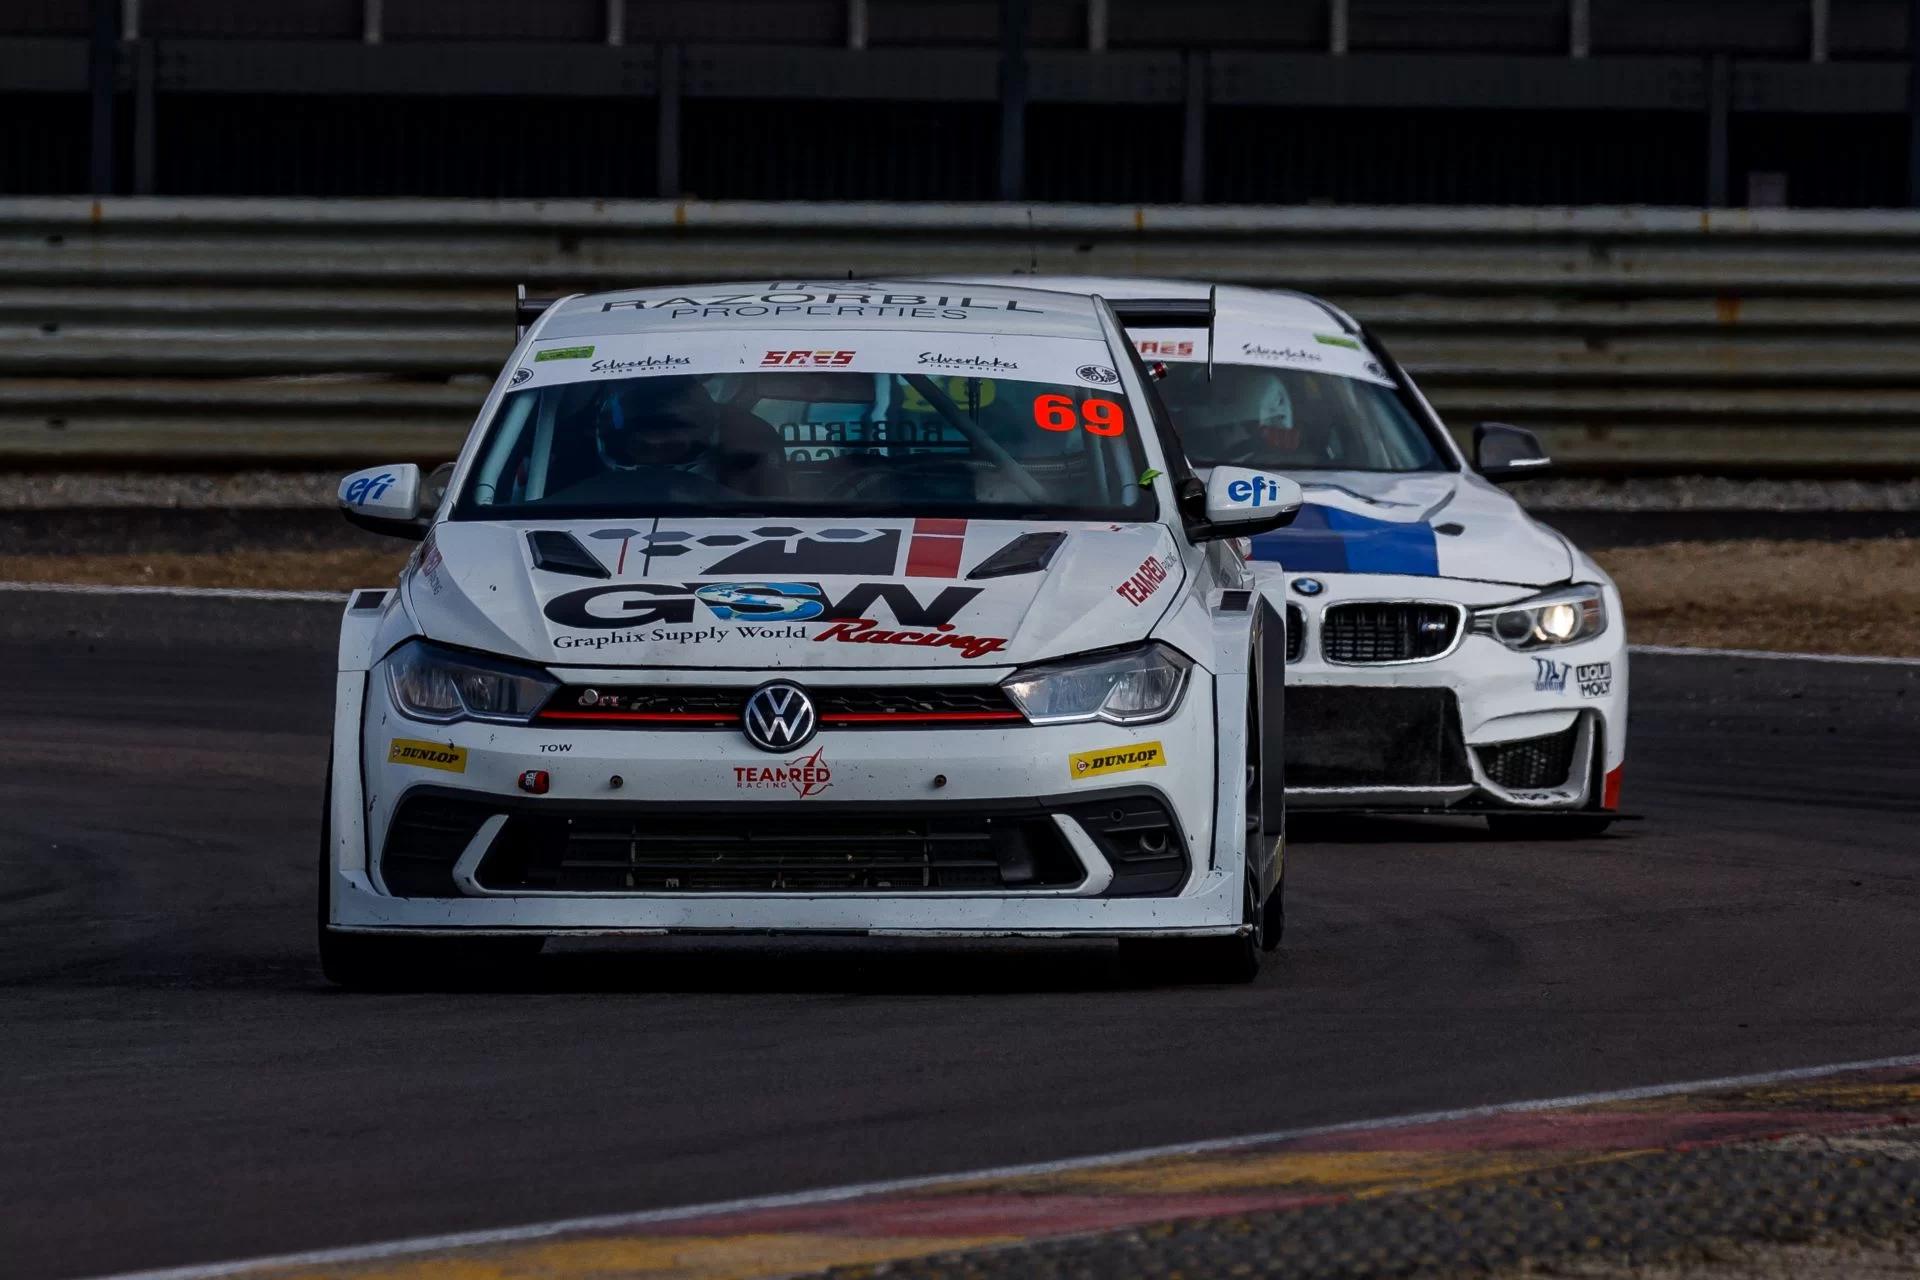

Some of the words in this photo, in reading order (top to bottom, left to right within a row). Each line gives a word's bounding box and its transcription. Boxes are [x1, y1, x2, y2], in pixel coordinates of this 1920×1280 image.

[601, 293, 1043, 314] RAZORBILL
[672, 305, 968, 319] PROPERTIES
[590, 354, 691, 372] Silverlakes
[918, 351, 1019, 370] Silverlakes
[1033, 394, 1124, 437] 69
[346, 473, 396, 506] efi
[1228, 476, 1277, 507] efi
[543, 582, 986, 629] GSW
[553, 631, 645, 649] Graphix
[650, 626, 730, 643] Supply
[735, 625, 807, 640] World
[812, 617, 1009, 659] Racing
[401, 746, 460, 764] DUNLOP
[539, 743, 573, 753] TOW
[1091, 749, 1158, 769] DUNLOP
[733, 767, 831, 783] TEAMRED
